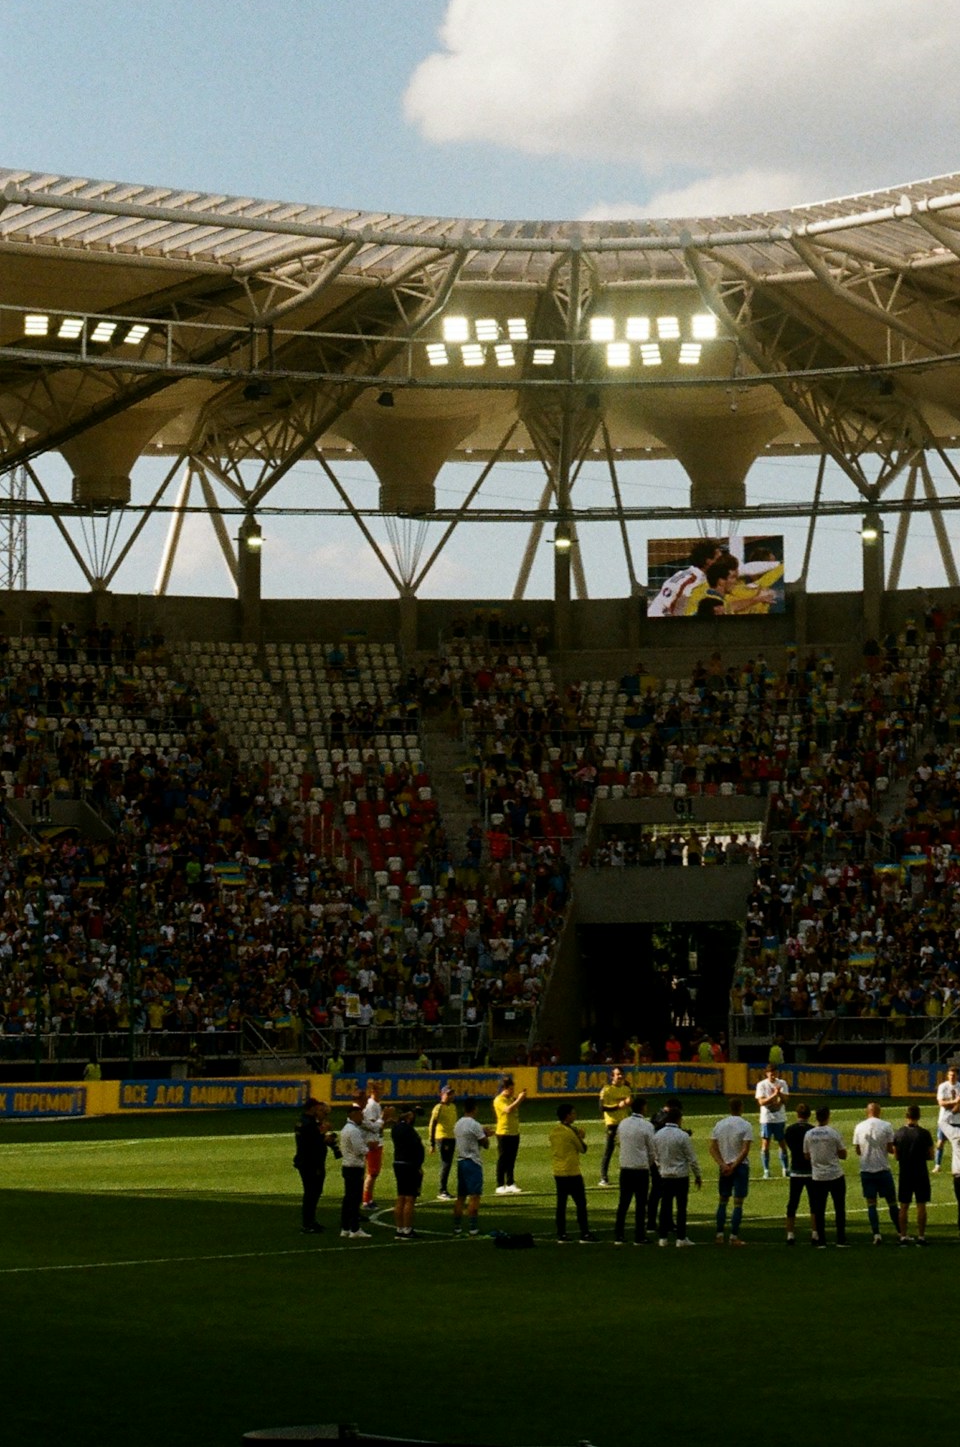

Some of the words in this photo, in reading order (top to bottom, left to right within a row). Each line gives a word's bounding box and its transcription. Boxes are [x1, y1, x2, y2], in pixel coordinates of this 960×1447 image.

[32, 799, 50, 817] H1
[673, 798, 692, 814] G1
[123, 1085, 148, 1104] ВСЕ
[153, 1085, 184, 1105] ДЛЯ
